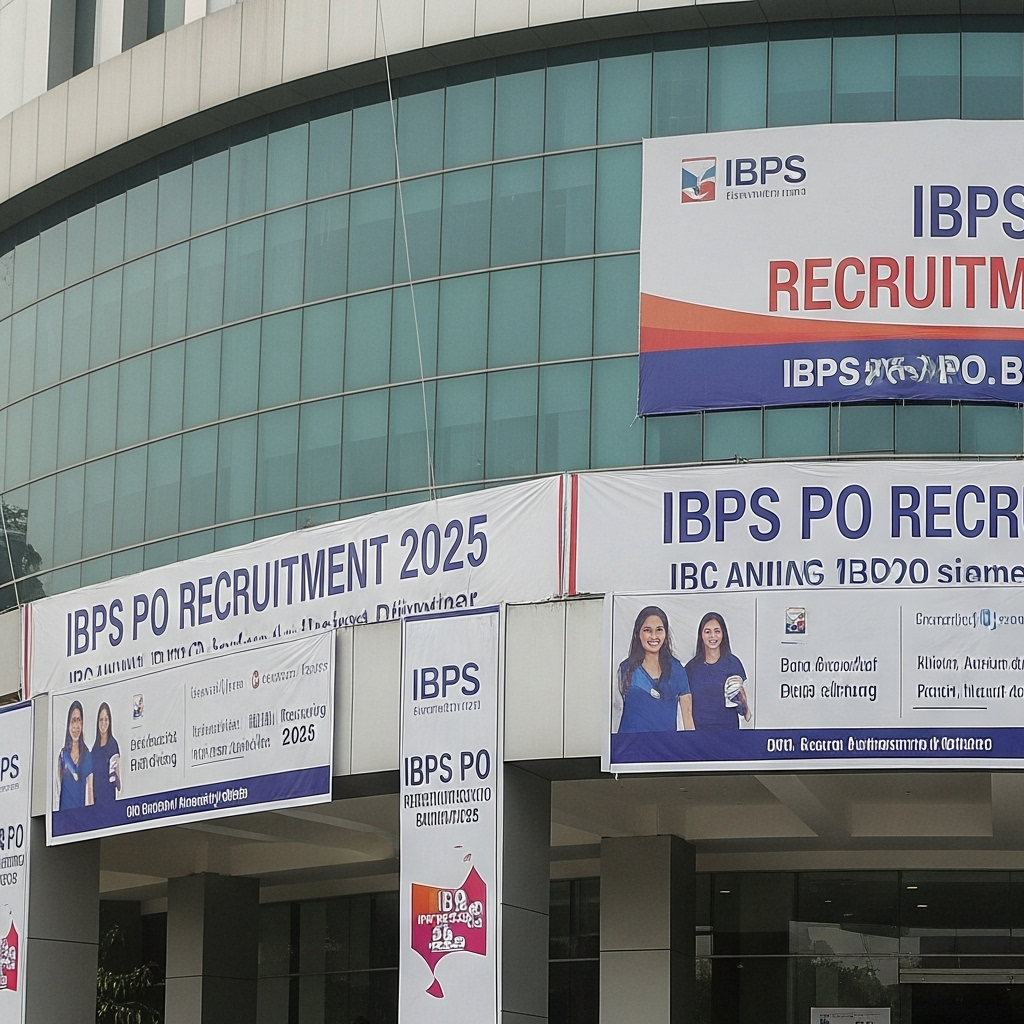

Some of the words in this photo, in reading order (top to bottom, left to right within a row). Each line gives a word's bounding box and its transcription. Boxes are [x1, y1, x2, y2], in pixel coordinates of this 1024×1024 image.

[726, 156, 807, 187] IBPS
[663, 486, 781, 545] IBPS
[801, 485, 873, 541] PO
[66, 598, 123, 657] IBPS
[132, 588, 168, 641] PO
[179, 535, 389, 629] RECRUITMENT
[400, 514, 489, 580] 2025
[413, 662, 480, 701] IBPS
[0, 754, 20, 780] PS
[404, 753, 452, 787] IBPS
[460, 749, 491, 781] PO
